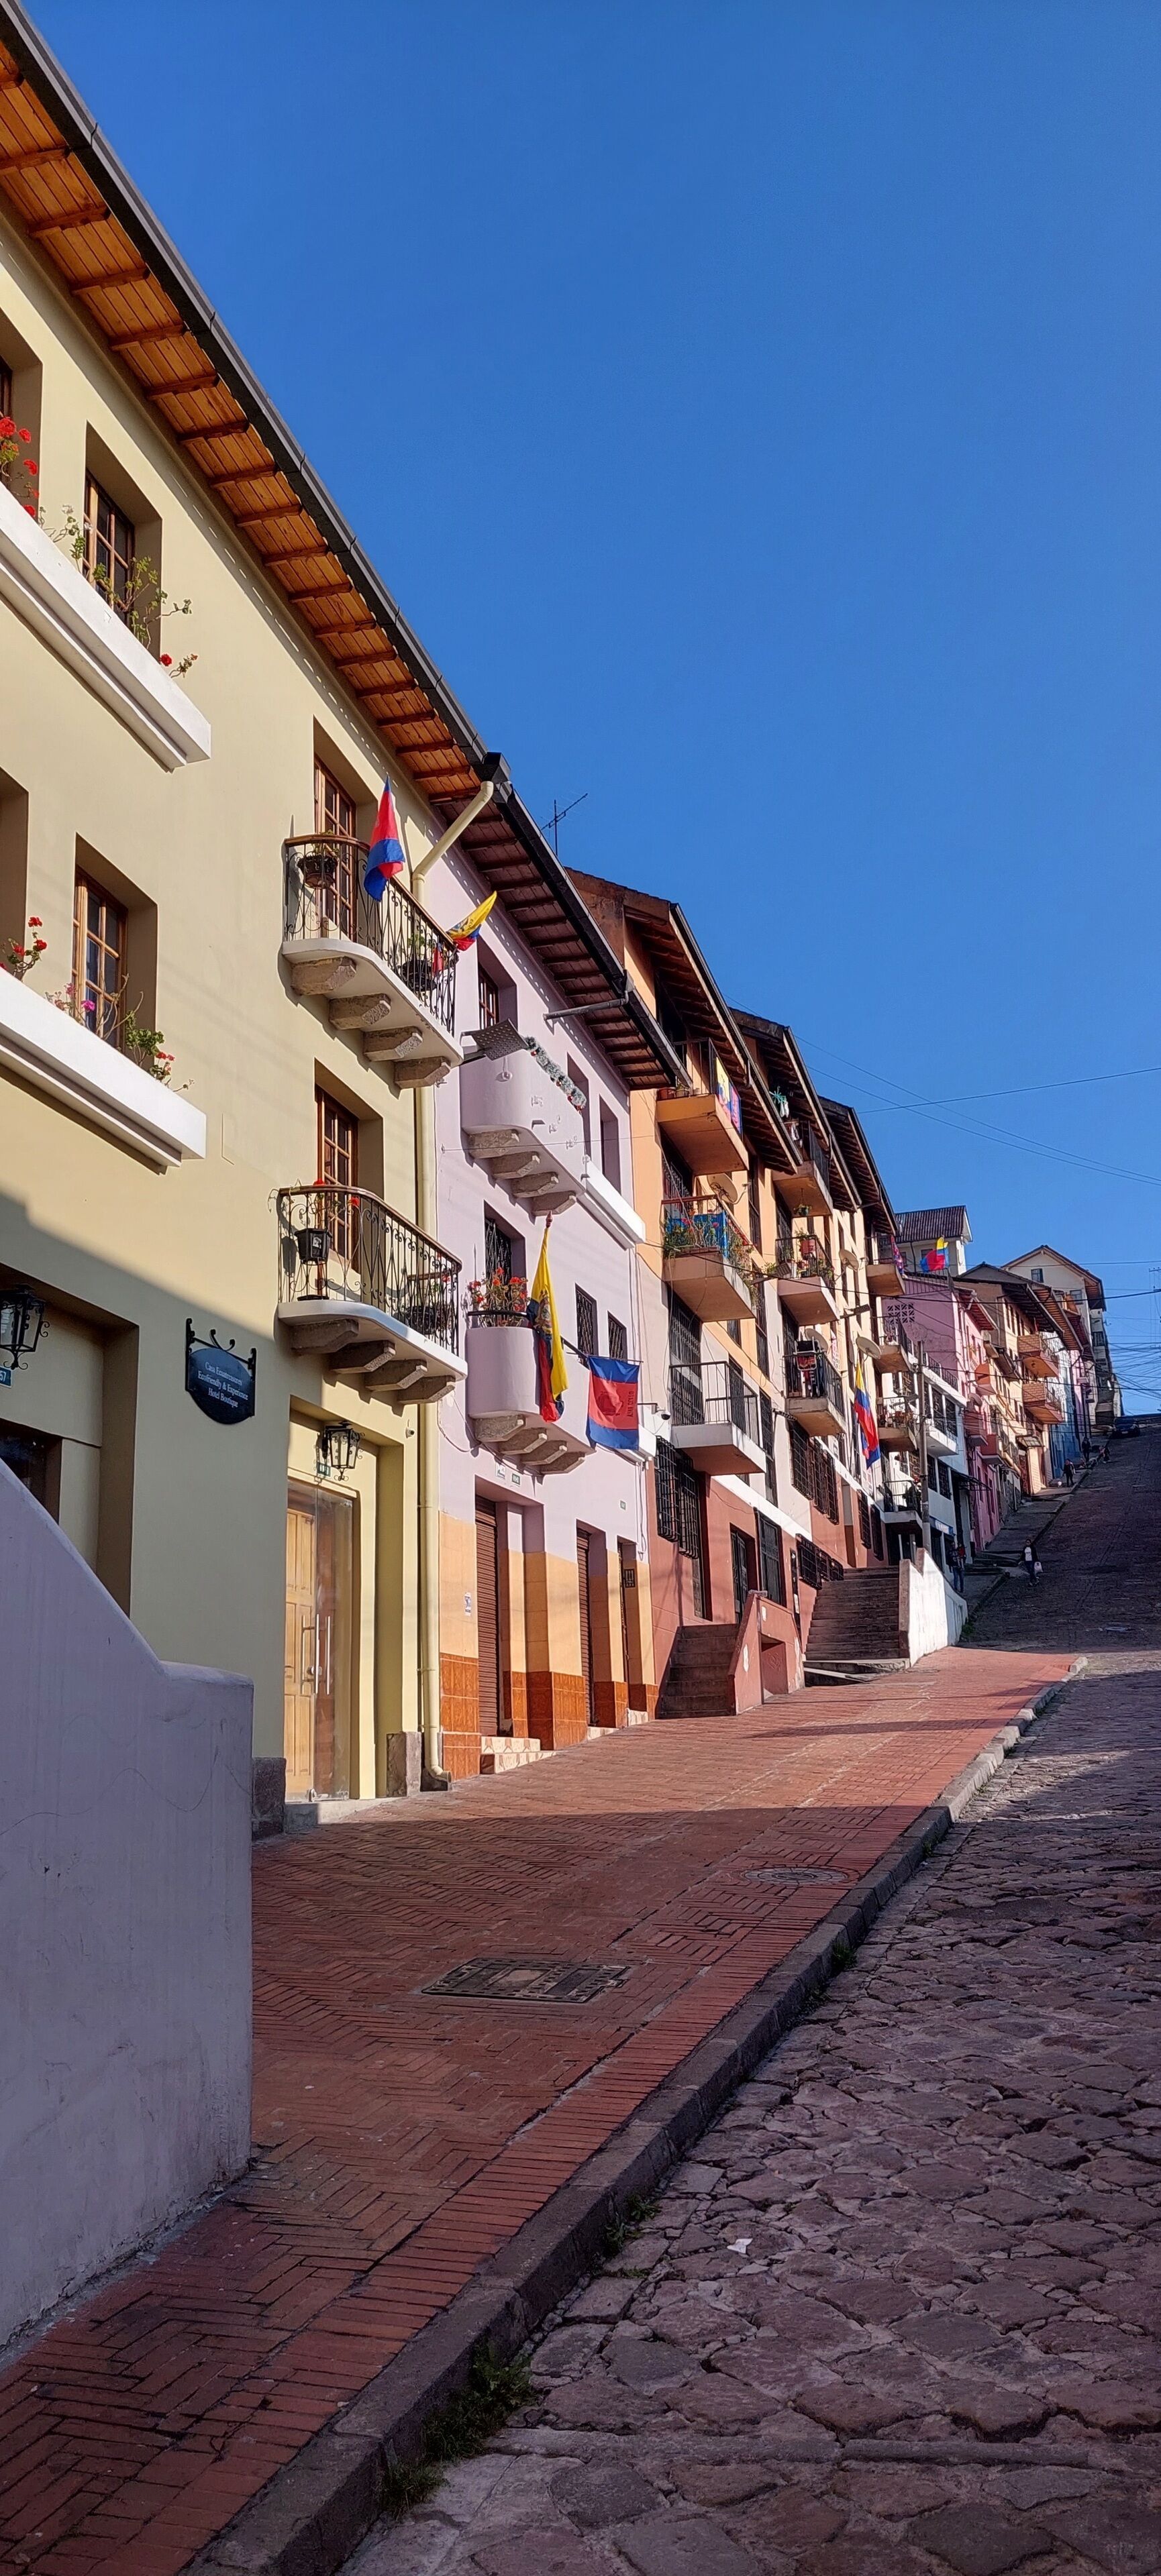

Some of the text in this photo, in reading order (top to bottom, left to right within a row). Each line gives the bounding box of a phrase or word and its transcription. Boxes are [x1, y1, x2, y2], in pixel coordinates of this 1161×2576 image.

[205, 1362, 215, 1373] Casa
[222, 1382, 227, 1391] &
[209, 1387, 238, 1408] Hotel Boutique
